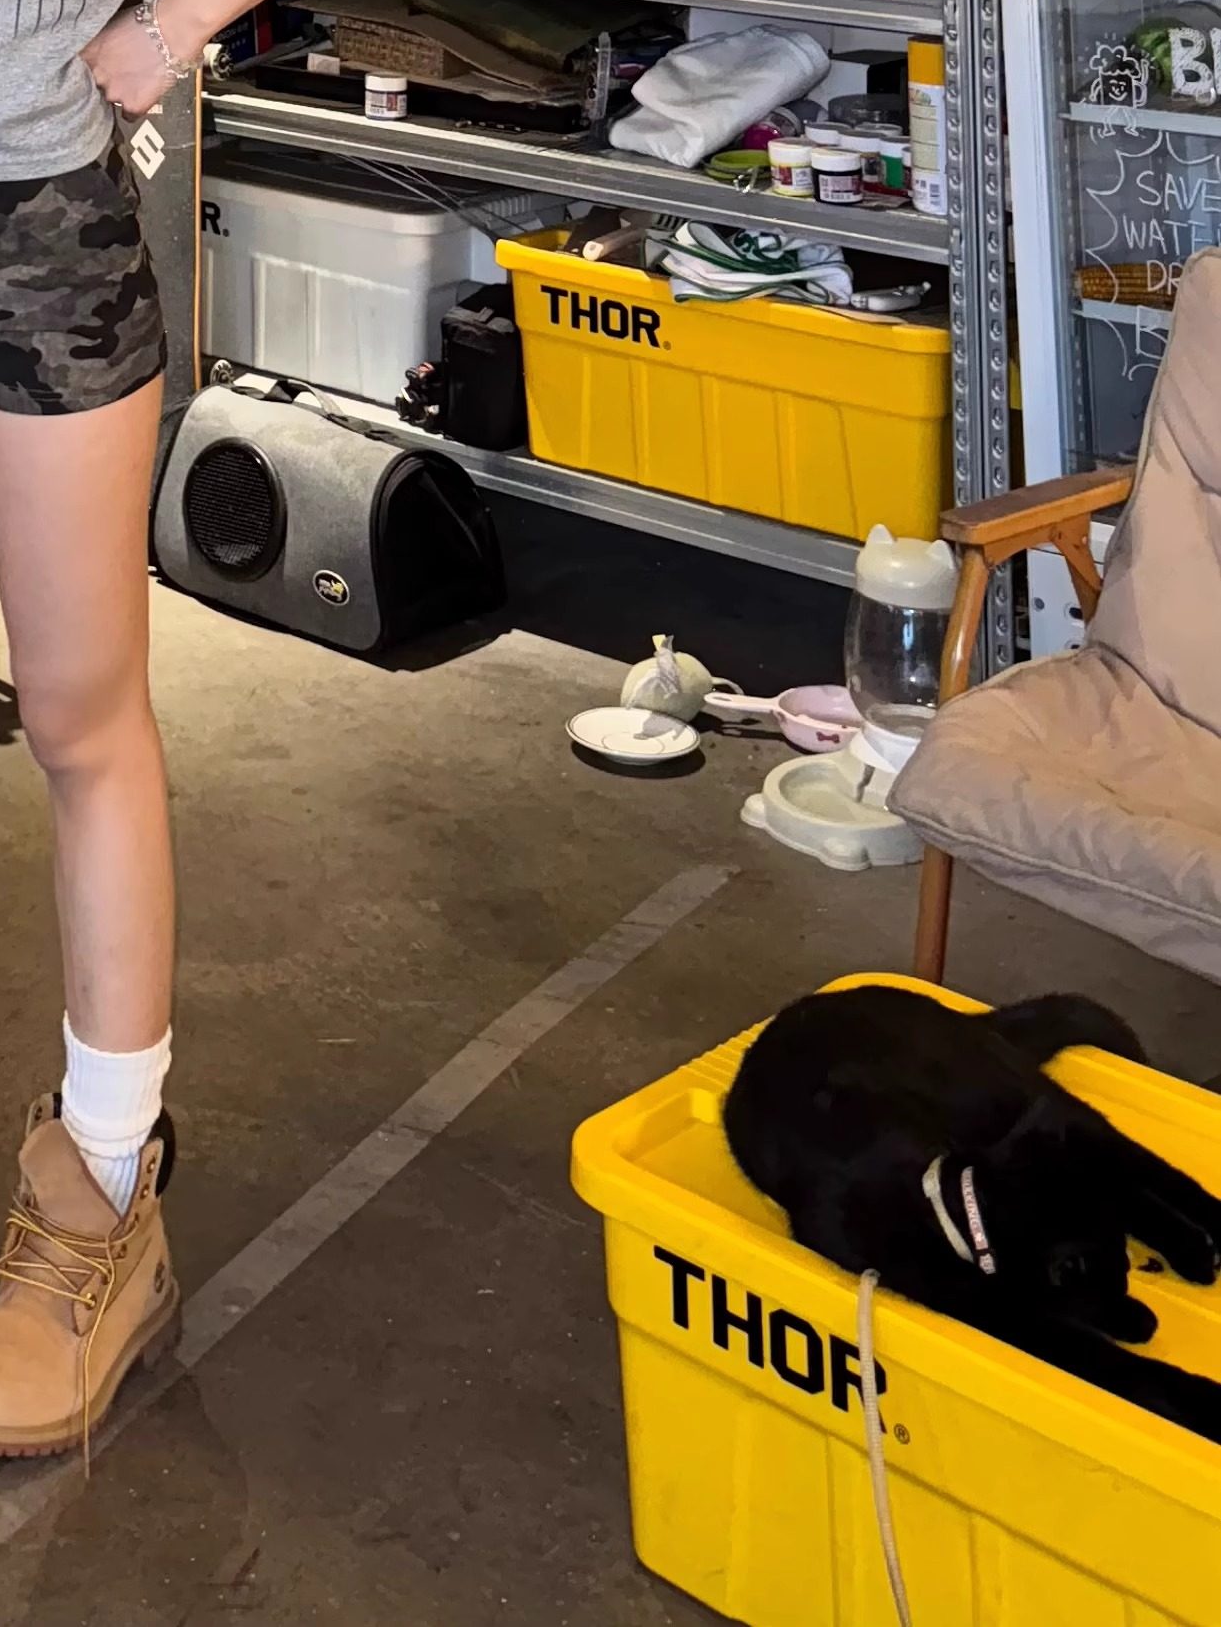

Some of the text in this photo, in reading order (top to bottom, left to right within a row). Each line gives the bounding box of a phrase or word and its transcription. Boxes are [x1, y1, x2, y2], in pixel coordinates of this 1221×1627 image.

[1136, 170, 1221, 212] SAVE
[1123, 214, 1221, 256] WATE
[1146, 260, 1183, 295] DR
[540, 284, 661, 349] THOR
[653, 1244, 888, 1435] THOR
